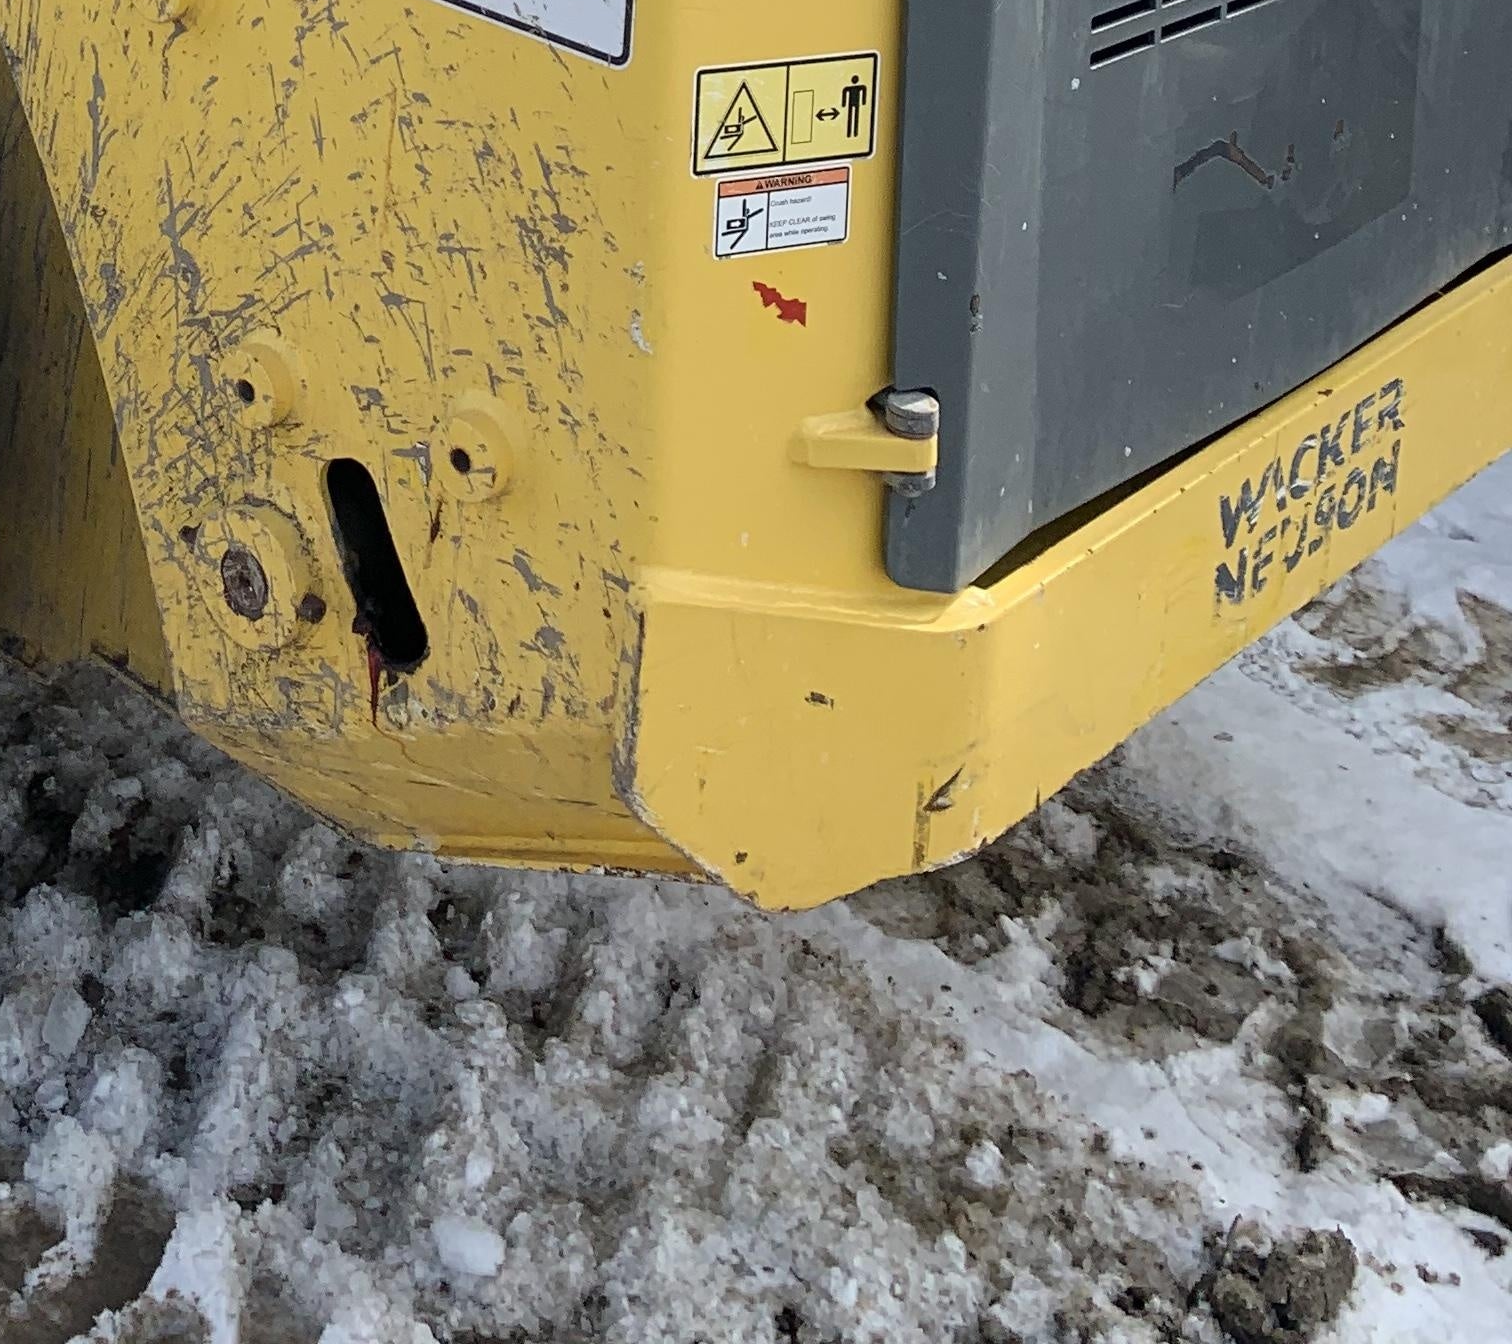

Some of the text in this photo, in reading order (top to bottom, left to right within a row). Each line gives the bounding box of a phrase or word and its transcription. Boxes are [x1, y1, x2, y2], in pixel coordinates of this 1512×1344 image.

[765, 174, 813, 189] WARNING
[788, 217, 811, 226] CLEAR
[1219, 377, 1406, 550] WACKER
